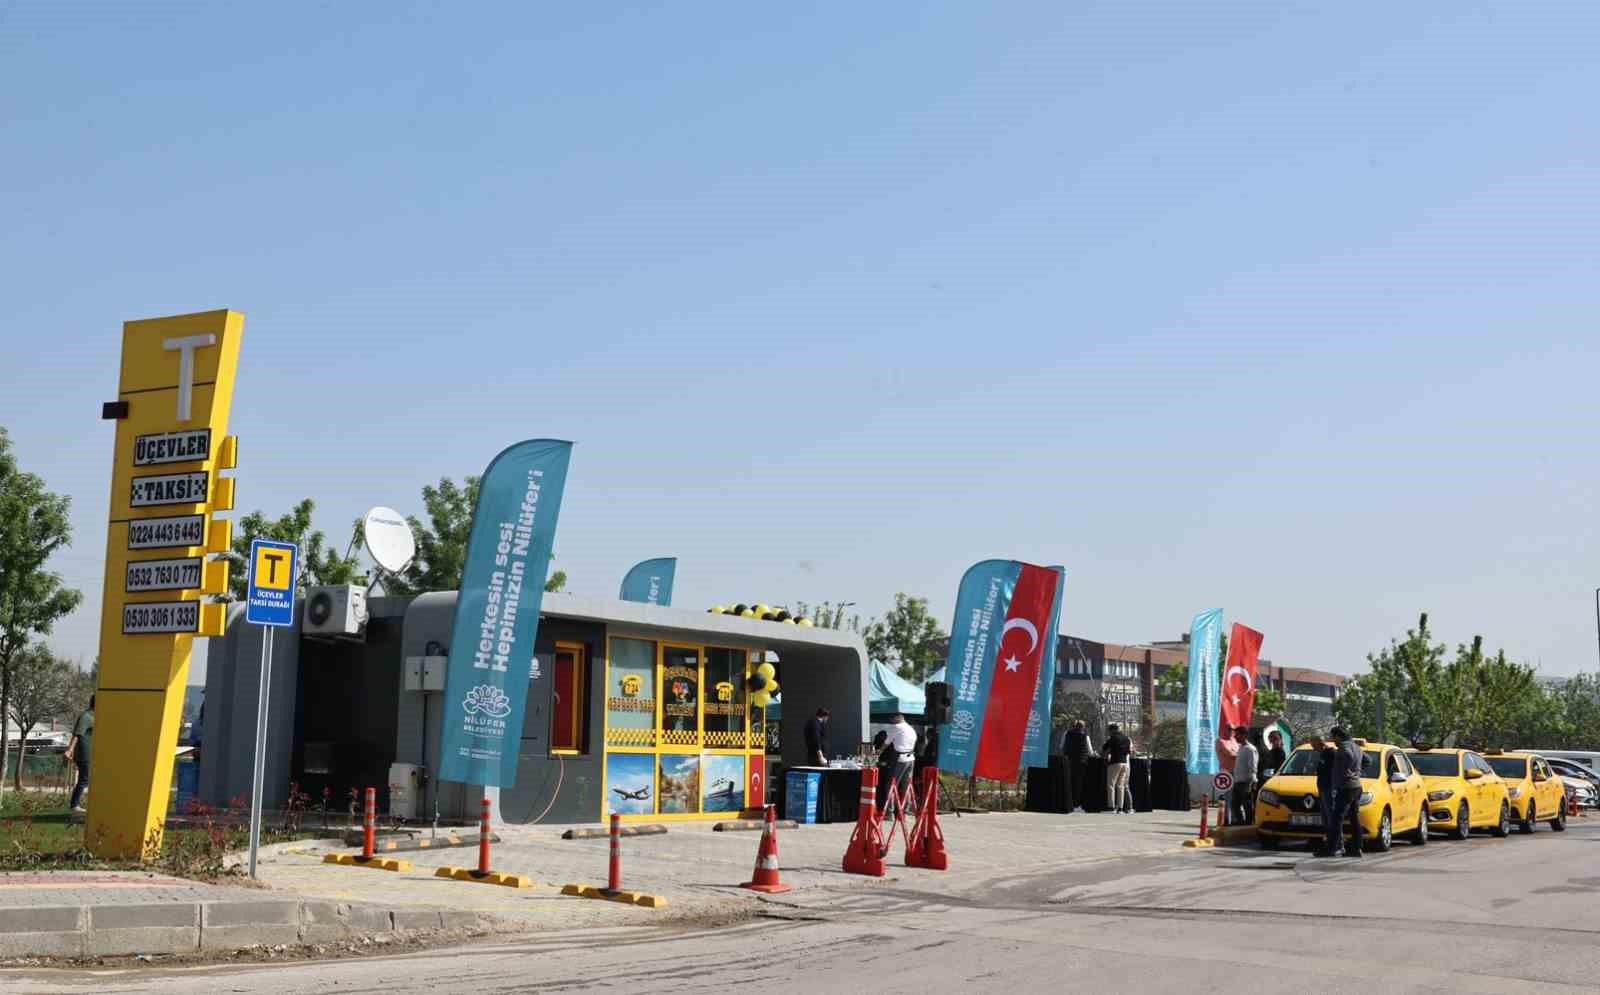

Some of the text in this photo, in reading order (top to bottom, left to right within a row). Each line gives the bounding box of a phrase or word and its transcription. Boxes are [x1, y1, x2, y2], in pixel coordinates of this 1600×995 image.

[162, 333, 216, 421] T
[136, 435, 207, 464] ÜÇEVLER
[144, 474, 193, 501] TAKSİ
[128, 567, 153, 587] 0532
[264, 553, 284, 585] T
[491, 469, 544, 672] Hepimizin Nilüfer'i
[474, 522, 515, 670] Herkesin sesi
[125, 608, 149, 628] 0530
